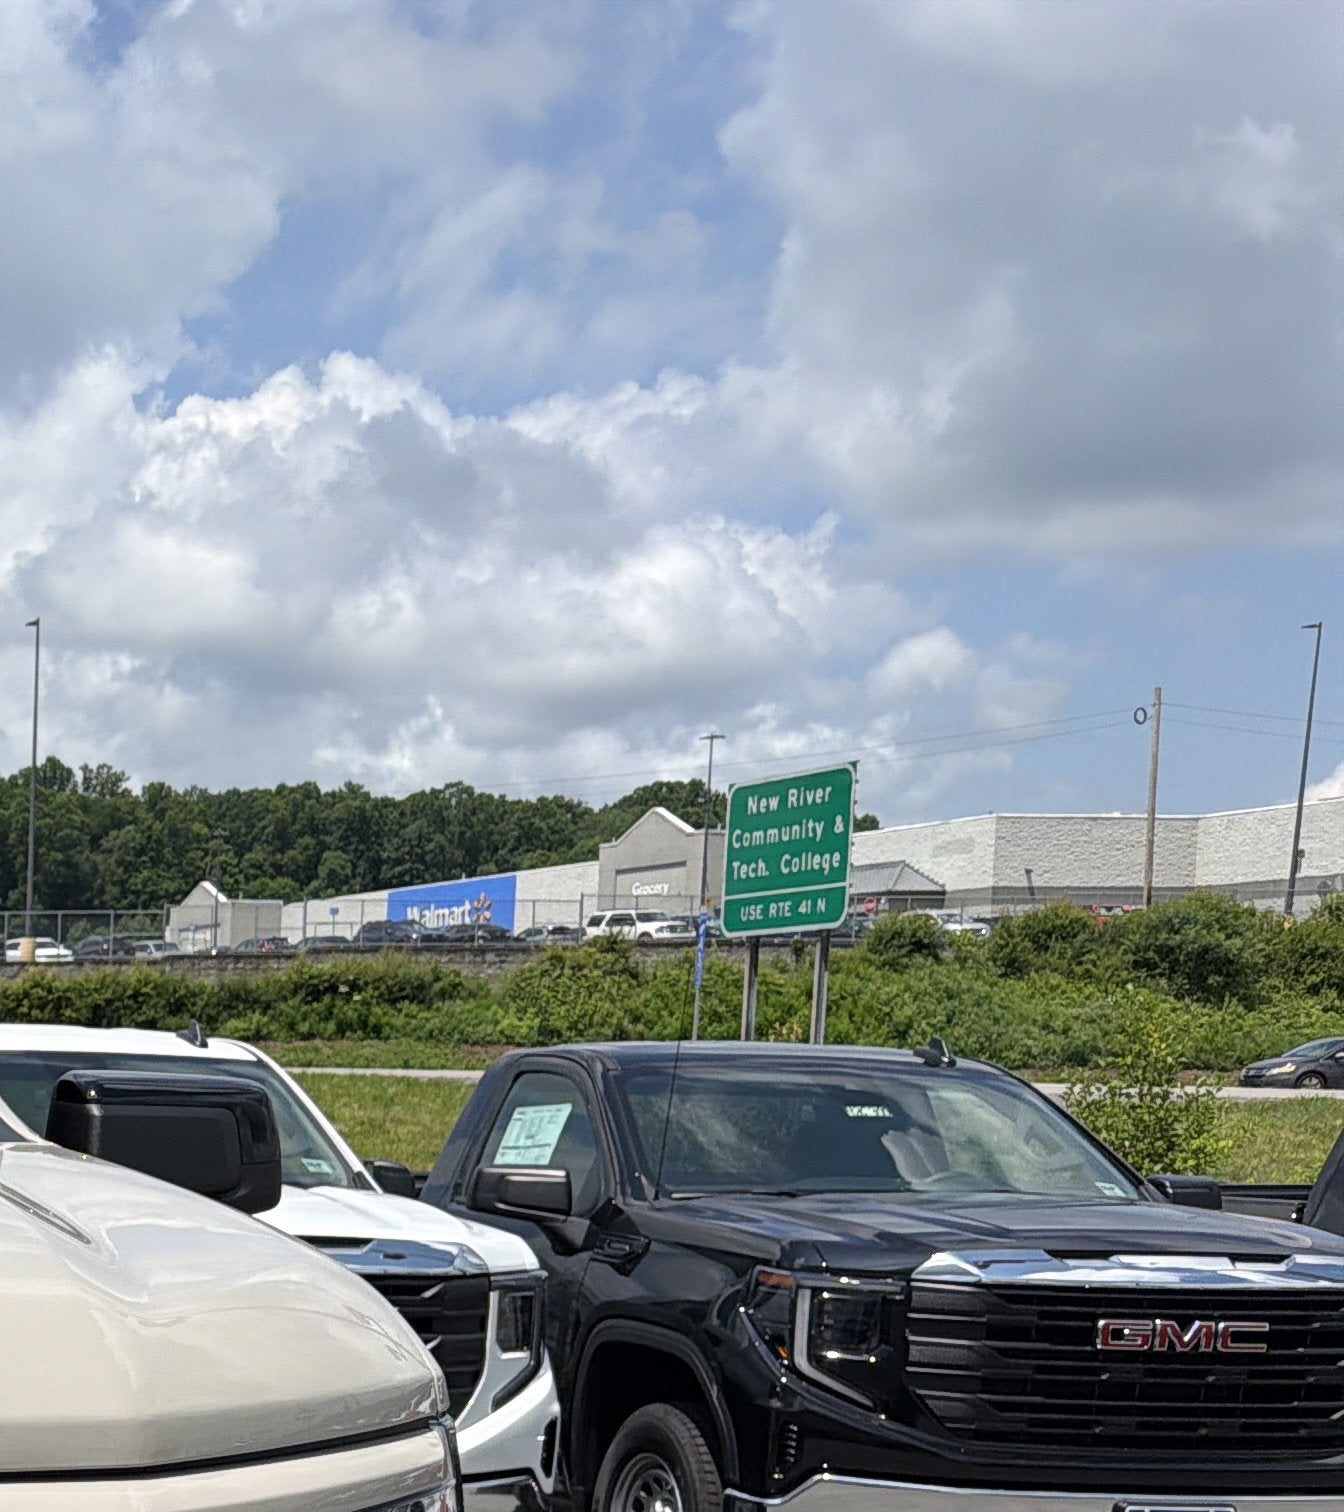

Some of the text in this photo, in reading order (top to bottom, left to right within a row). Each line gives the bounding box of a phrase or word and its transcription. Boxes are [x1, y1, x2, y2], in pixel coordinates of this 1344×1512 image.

[747, 786, 833, 816] New River
[732, 814, 845, 849] Community &
[732, 851, 841, 880] Tech. College
[407, 899, 471, 927] Walmart
[740, 898, 826, 922] USE RTE 41 N
[1096, 1319, 1270, 1352] GMC
